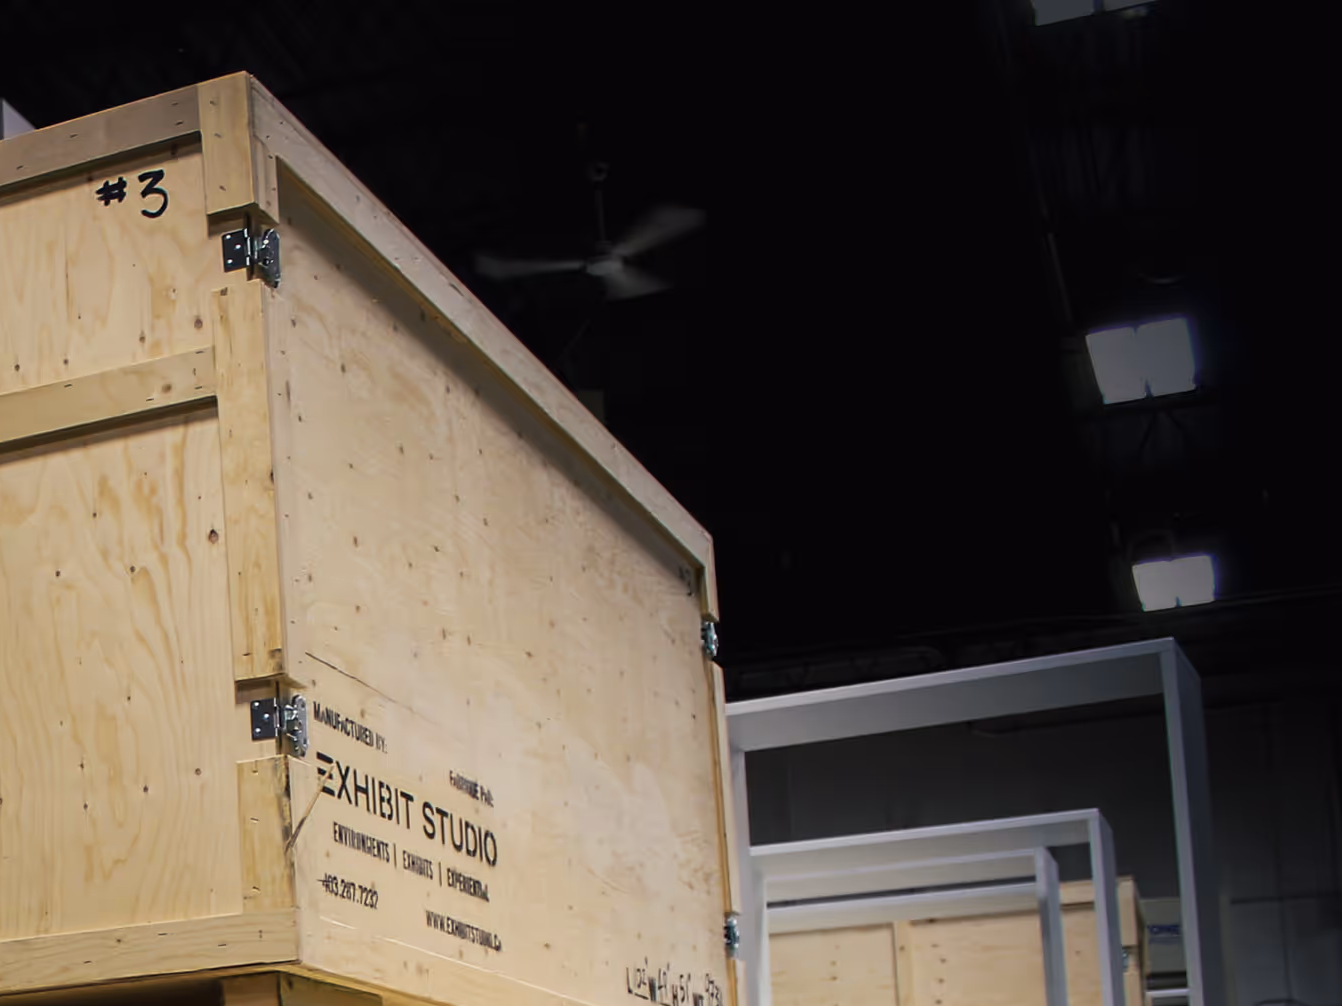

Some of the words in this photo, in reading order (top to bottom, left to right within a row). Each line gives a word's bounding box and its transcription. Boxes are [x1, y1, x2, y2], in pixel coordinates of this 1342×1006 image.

[95, 168, 169, 219] #3
[316, 751, 415, 829] EXHIBIT
[422, 801, 498, 868] STUDIO
